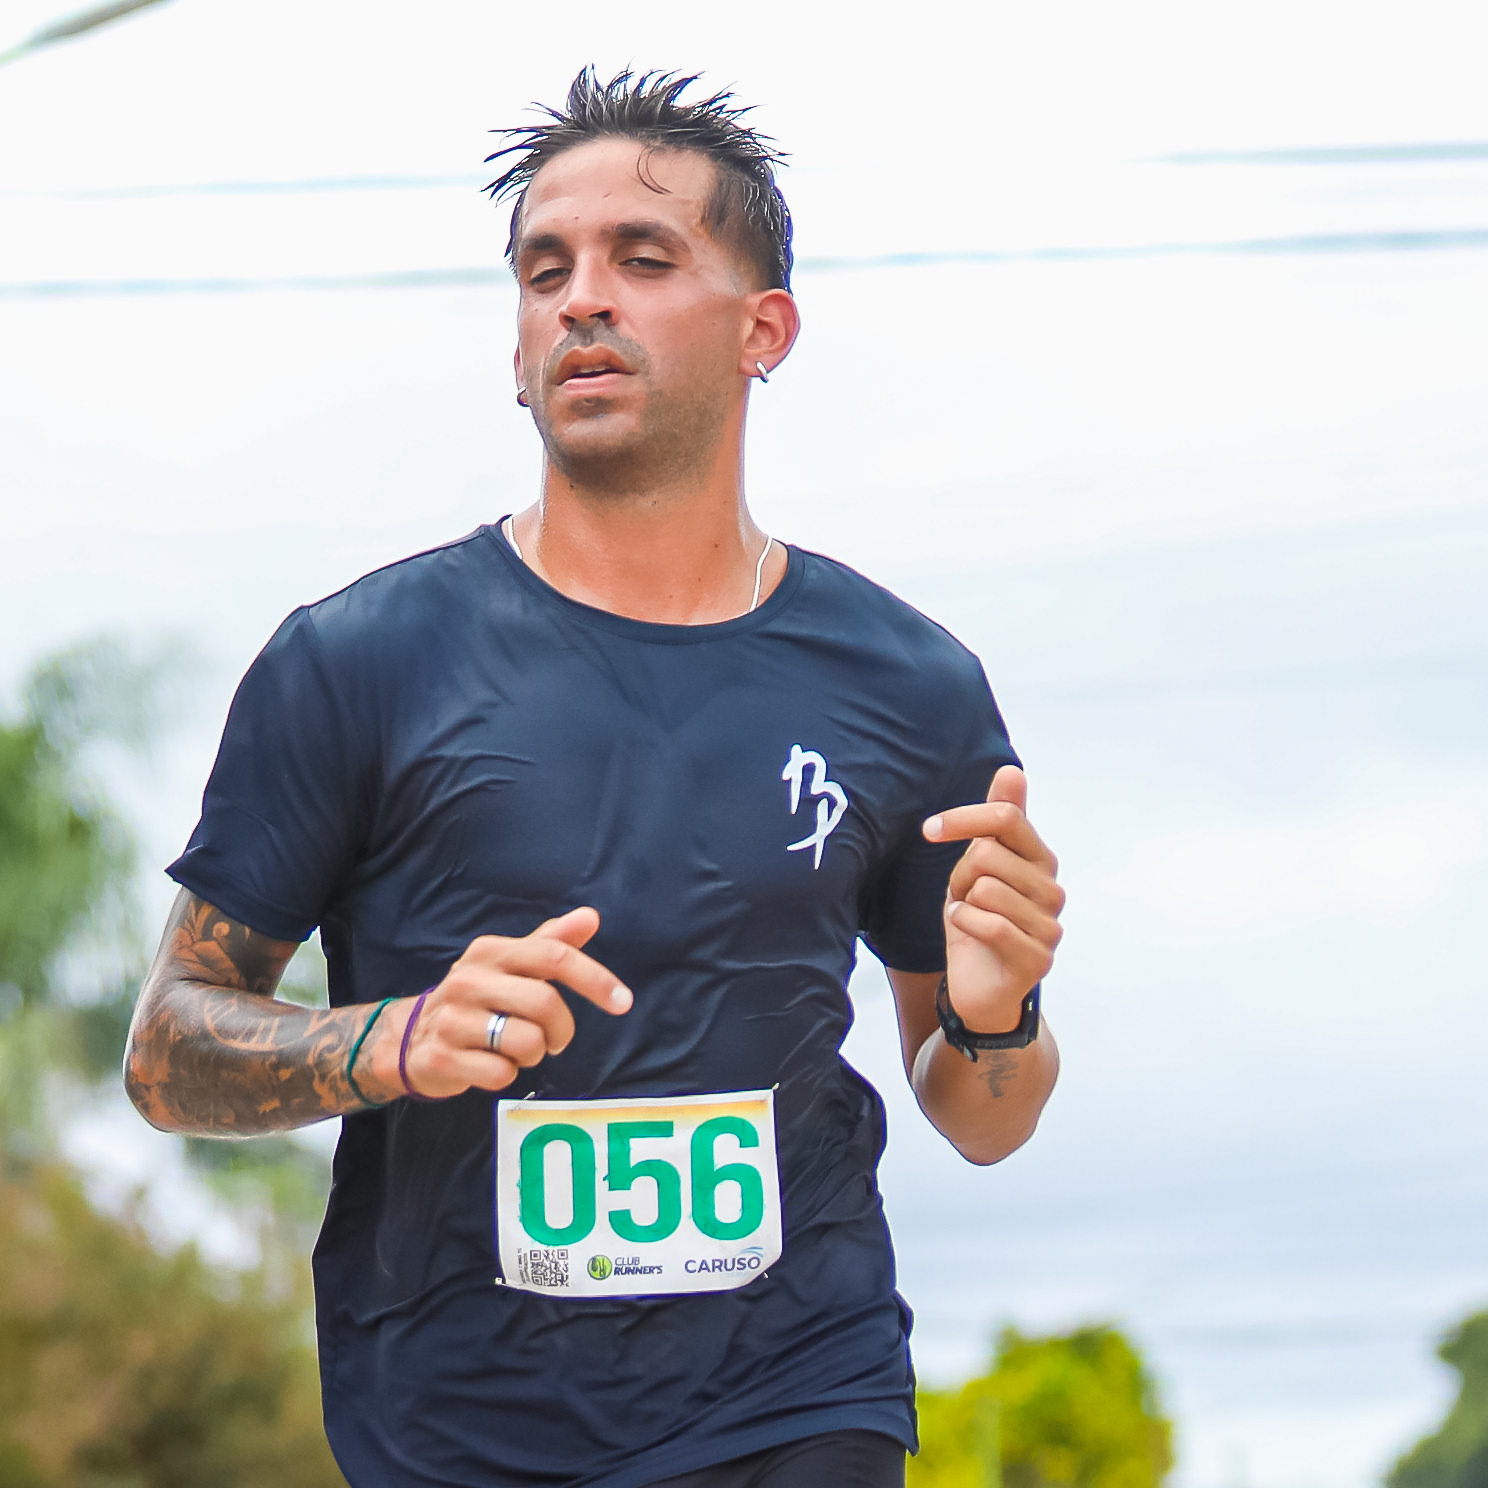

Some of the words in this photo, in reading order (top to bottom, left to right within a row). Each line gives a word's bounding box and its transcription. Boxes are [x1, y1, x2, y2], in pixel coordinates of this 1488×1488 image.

[519, 1115, 764, 1246] 056
[615, 1257, 640, 1266] CLUB
[684, 1256, 761, 1274] CARUSO
[614, 1265, 664, 1276] RUNNER'S
